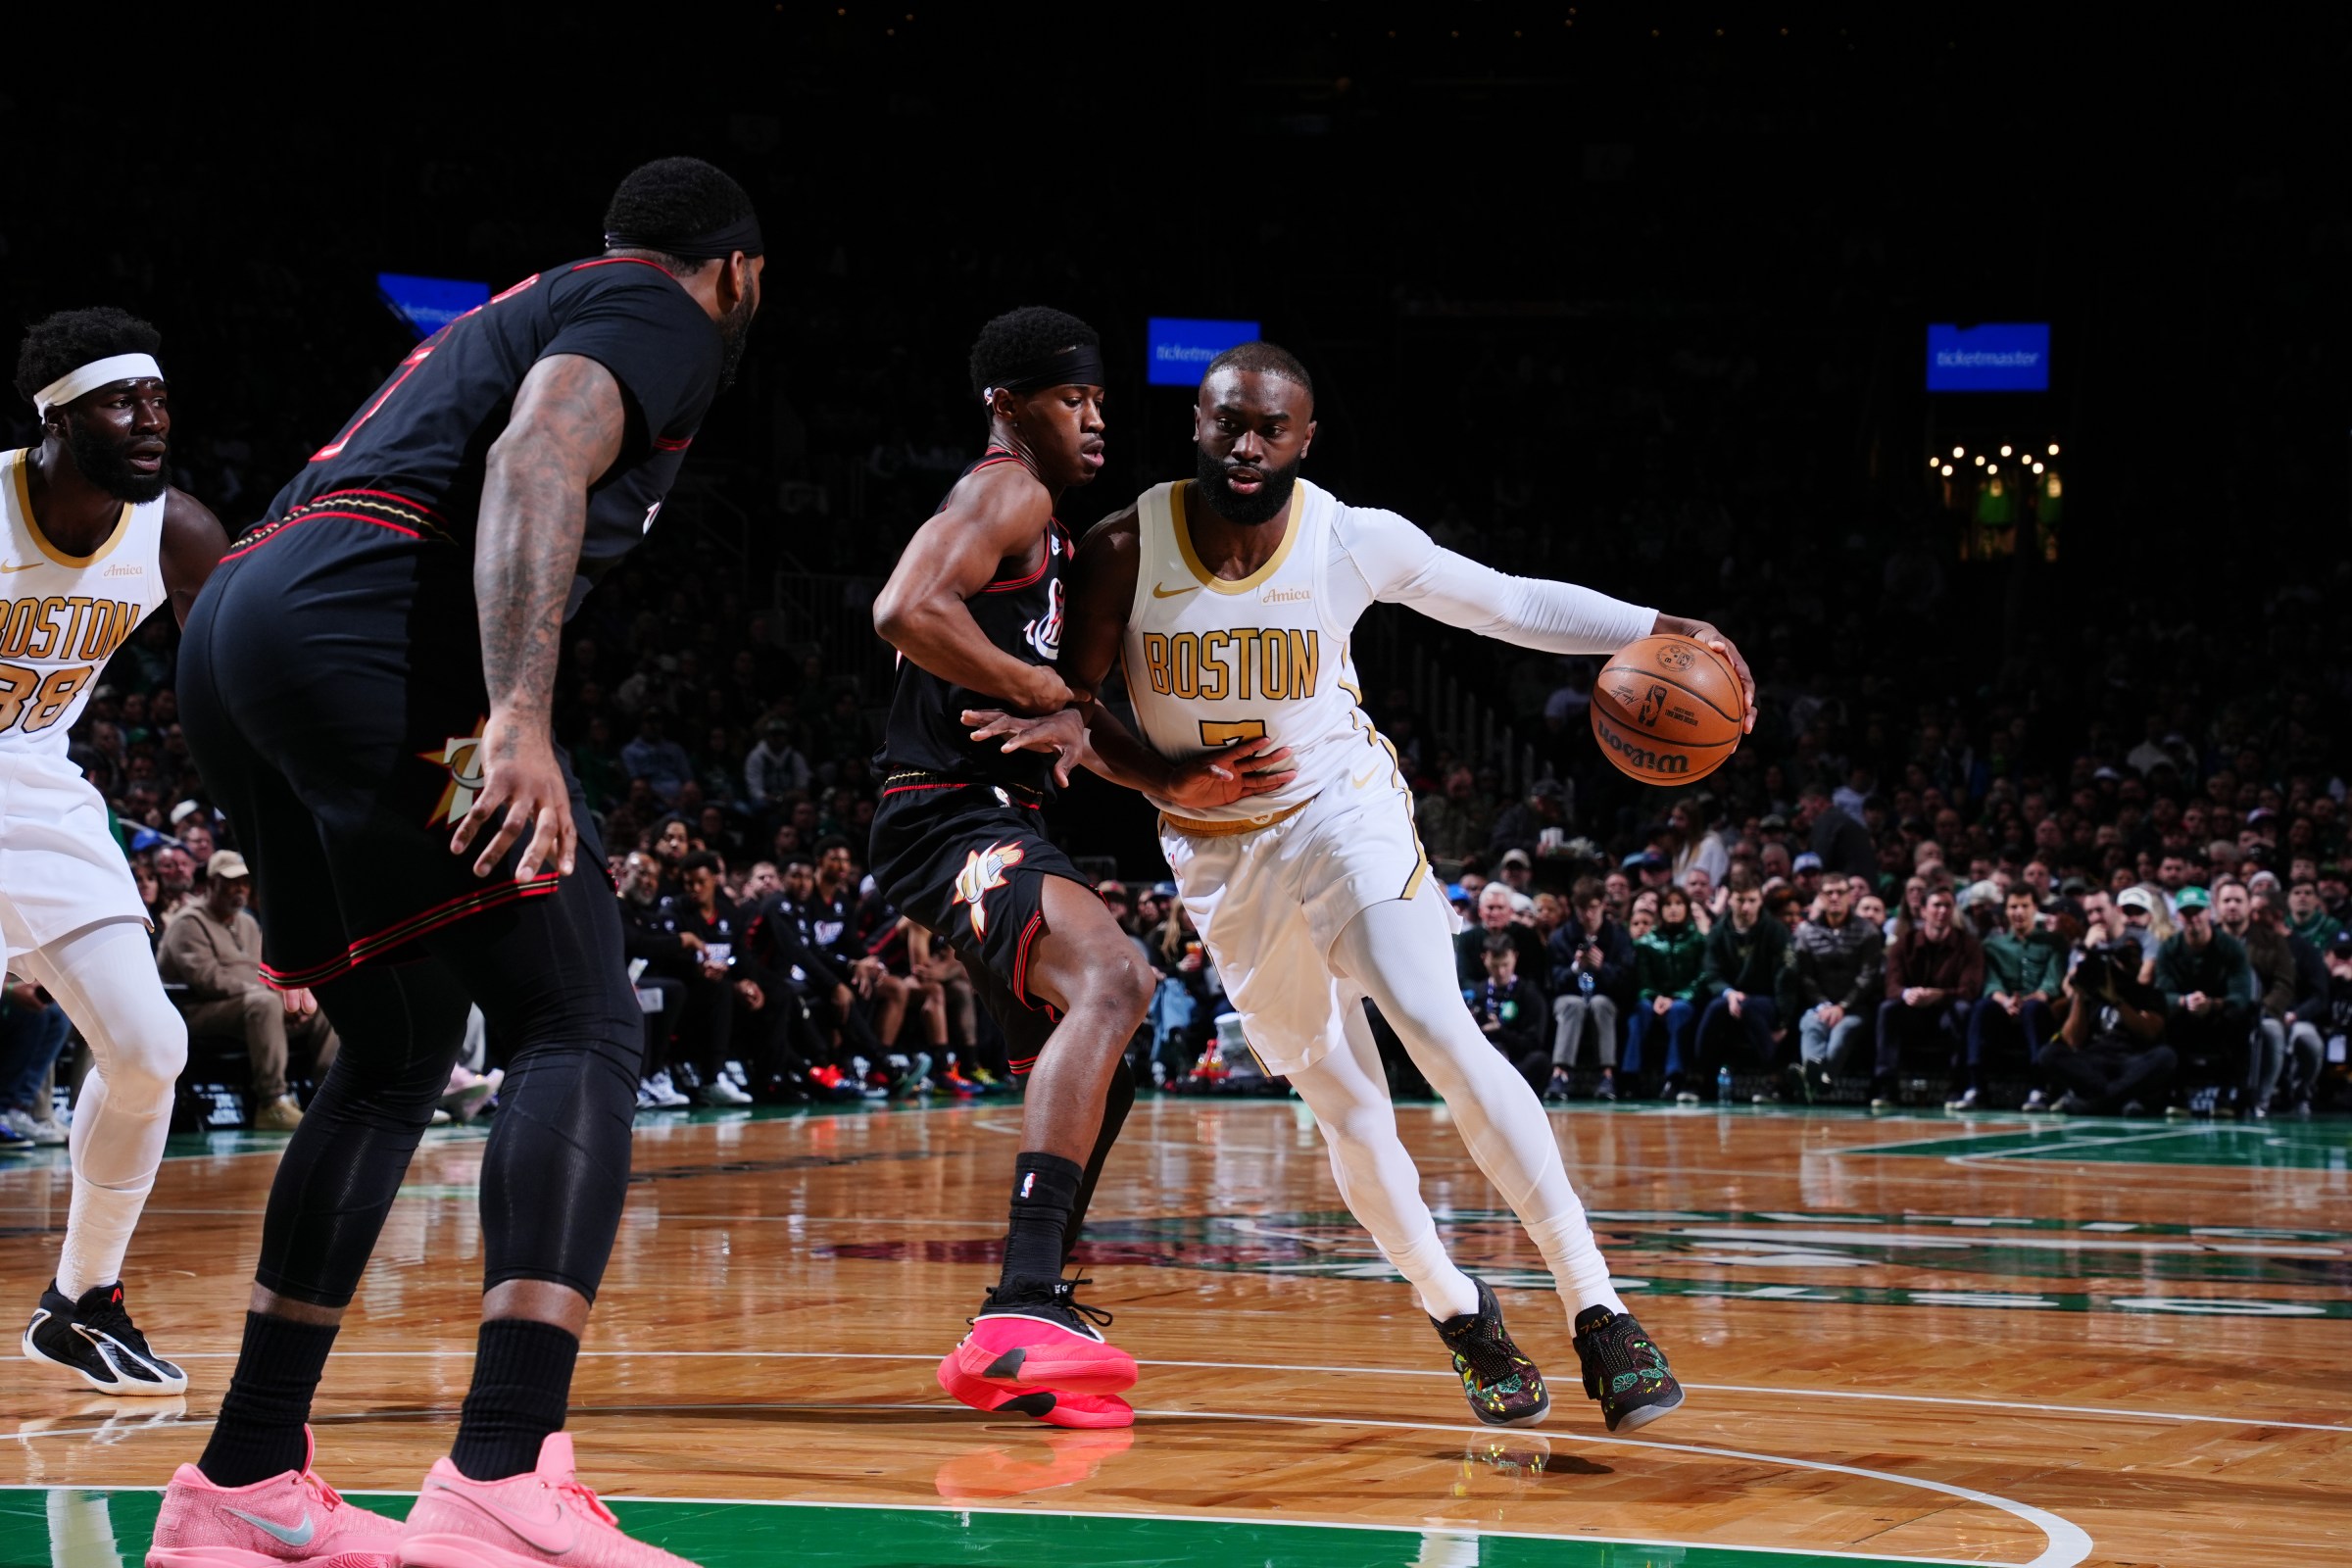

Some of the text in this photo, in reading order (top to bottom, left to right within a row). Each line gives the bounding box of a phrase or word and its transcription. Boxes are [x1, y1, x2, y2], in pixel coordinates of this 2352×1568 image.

[104, 564, 143, 576] Amica
[1262, 588, 1310, 604] Amica
[1143, 627, 1319, 701] BOSTON
[1597, 720, 1690, 773] Wilson
